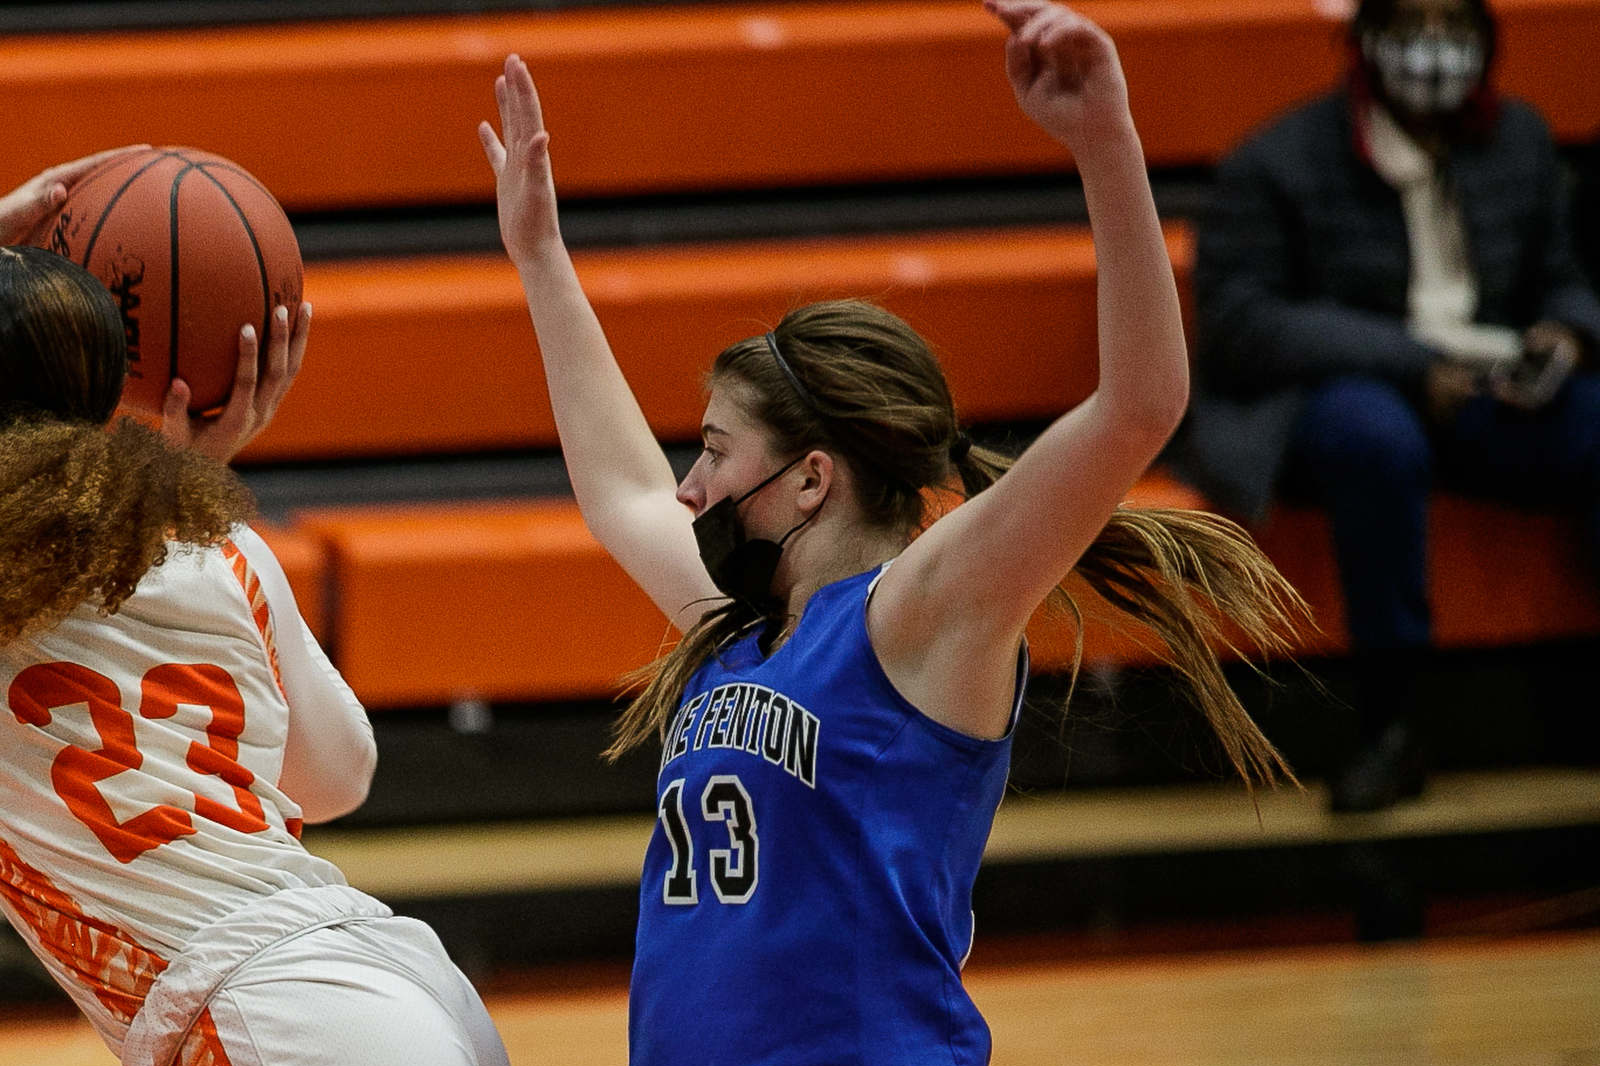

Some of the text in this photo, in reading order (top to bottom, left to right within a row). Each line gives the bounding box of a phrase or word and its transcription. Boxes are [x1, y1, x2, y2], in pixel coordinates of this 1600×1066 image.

[8, 661, 271, 864] 23
[693, 682, 820, 789] FENTON
[658, 775, 760, 904] 13
